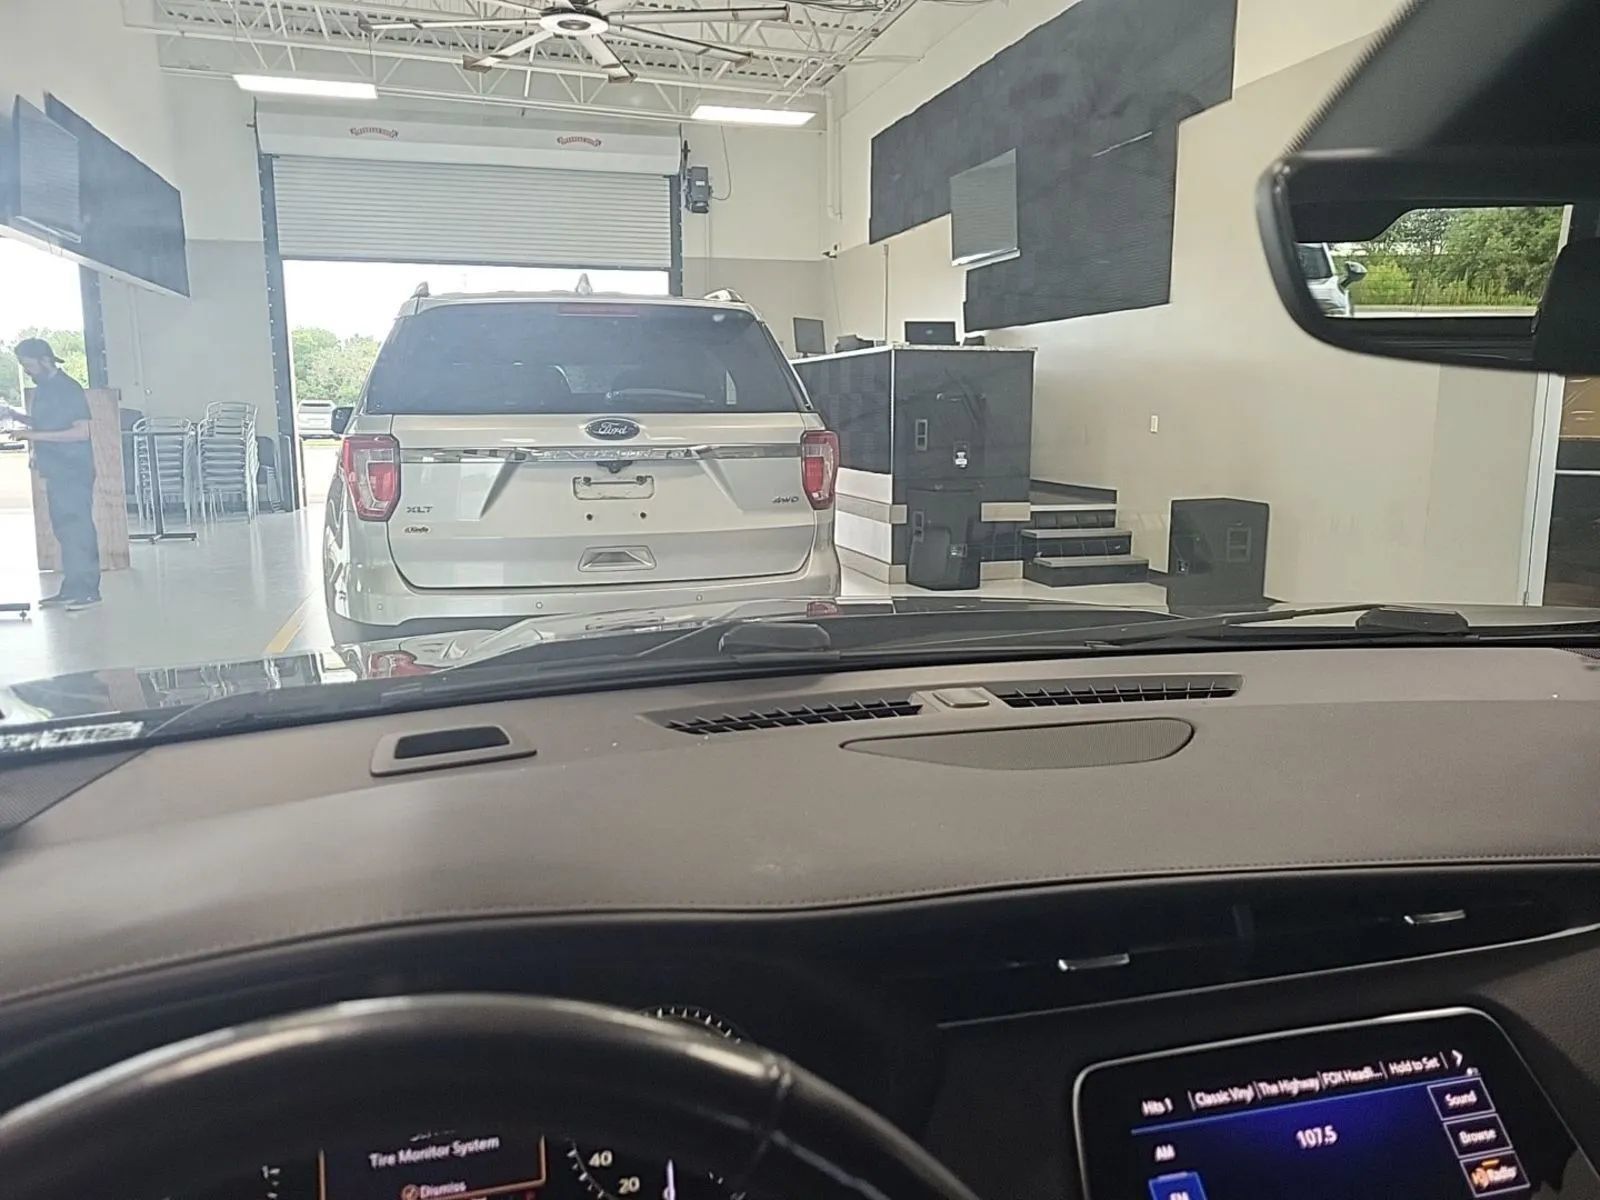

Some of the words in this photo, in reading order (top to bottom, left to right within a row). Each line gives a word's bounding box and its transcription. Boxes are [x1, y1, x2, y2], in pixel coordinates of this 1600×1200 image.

[598, 421, 629, 436] Ford
[406, 505, 433, 514] XLT
[1389, 1061, 1412, 1075] Hold
[1413, 1059, 1423, 1071] to
[1423, 1056, 1440, 1070] Set
[1258, 1081, 1278, 1096] The
[1278, 1077, 1320, 1097] Highway
[1322, 1071, 1346, 1086] FOX
[1194, 1090, 1229, 1108] Classic
[1228, 1084, 1255, 1104] Vinyl
[1445, 1089, 1477, 1107] Sound
[1142, 1100, 1166, 1116] Hits
[1164, 1097, 1173, 1113] 1
[1296, 1125, 1338, 1149] 107.5
[1459, 1128, 1497, 1146] Browse
[369, 1153, 397, 1169] Tire
[398, 1144, 450, 1164] Monitor
[452, 1137, 500, 1157] System
[588, 1150, 613, 1167] 40
[1155, 1144, 1176, 1161] AM
[420, 1181, 467, 1199] Dismiss
[618, 1176, 640, 1194] 20
